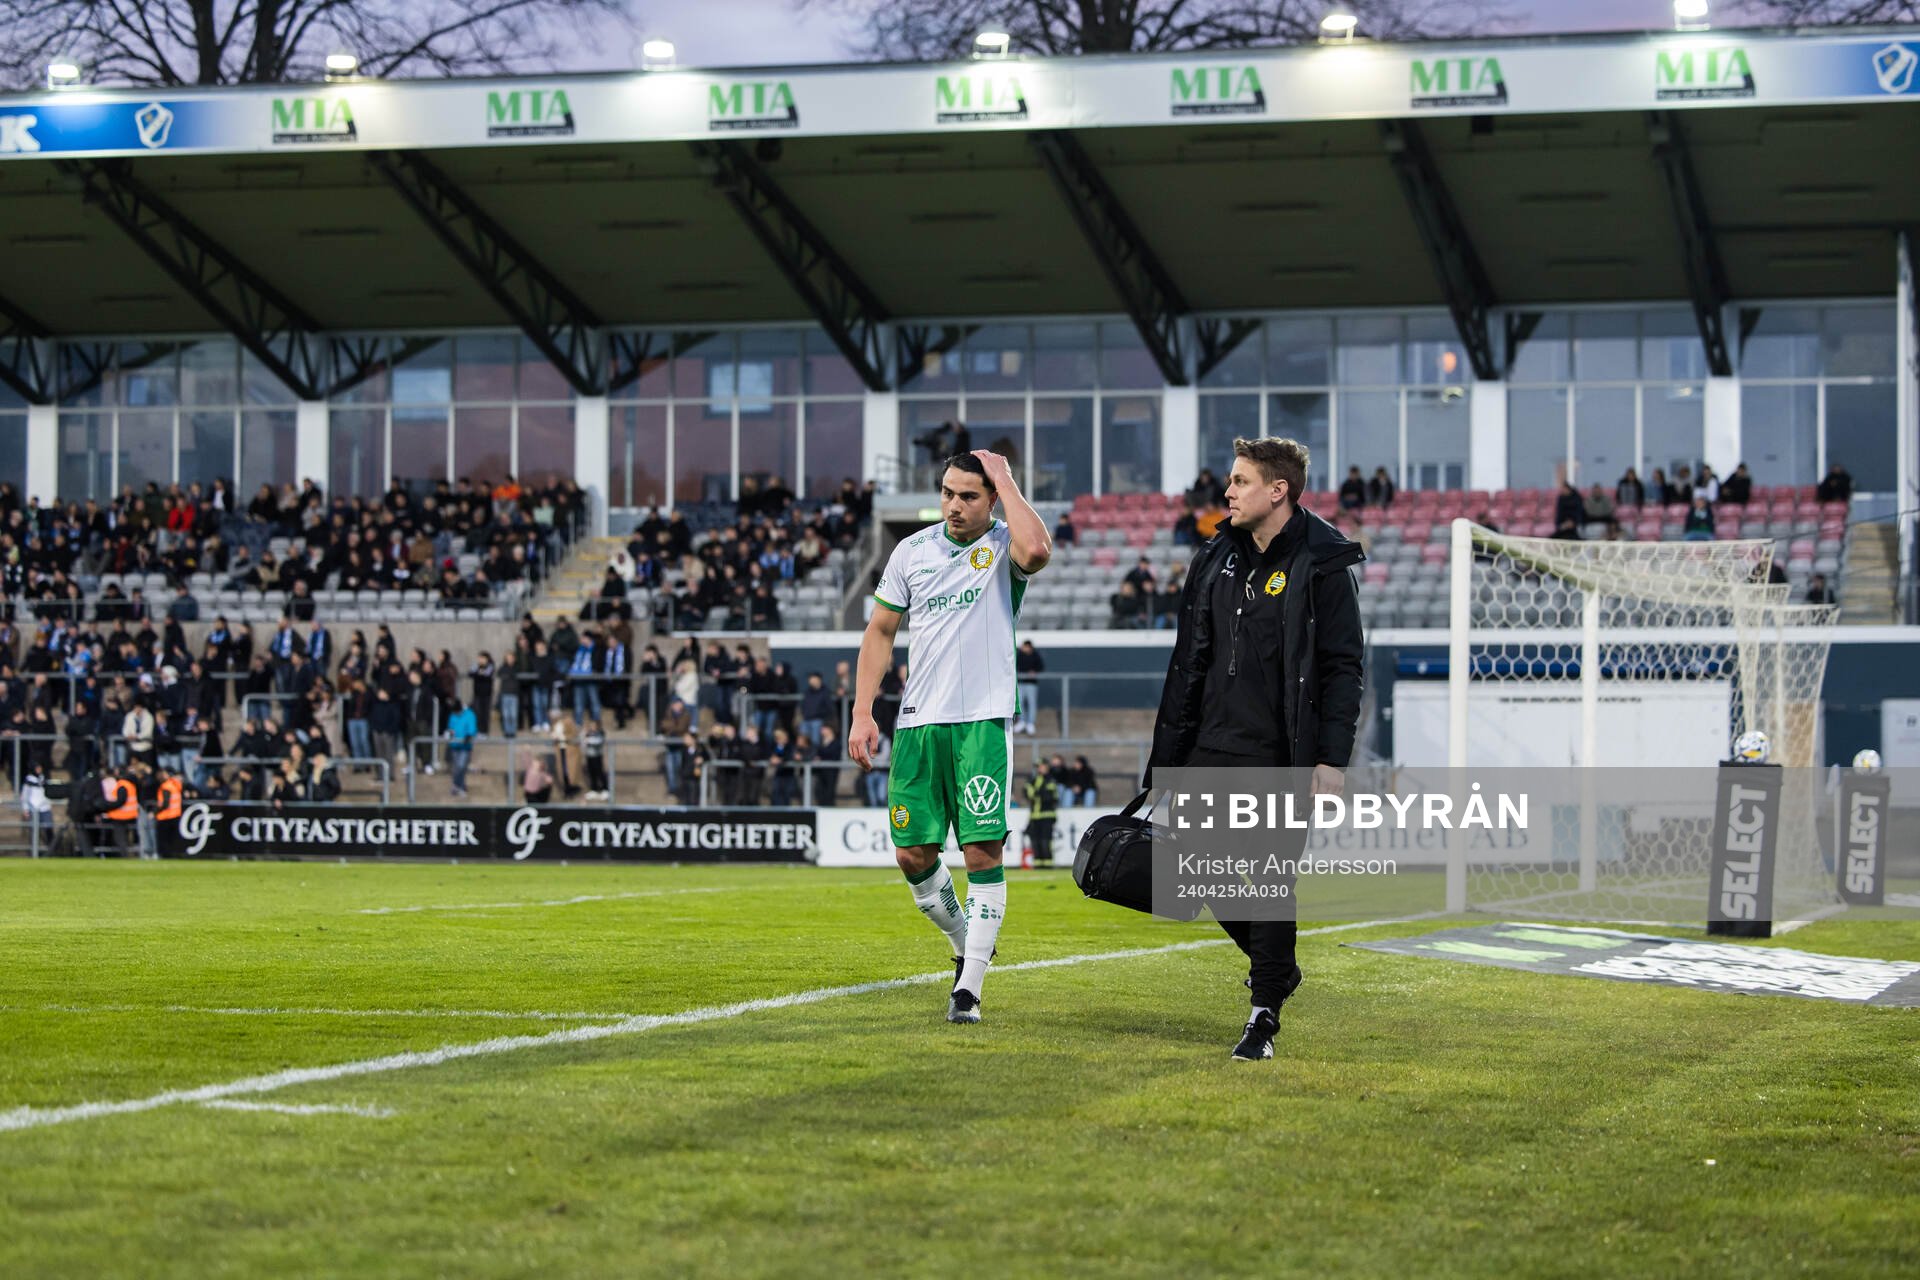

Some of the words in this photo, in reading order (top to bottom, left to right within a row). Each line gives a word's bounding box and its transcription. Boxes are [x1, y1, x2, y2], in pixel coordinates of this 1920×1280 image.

[1170, 67, 1265, 102] MTA
[1410, 58, 1507, 93] MTA
[487, 90, 574, 124] MTA
[708, 83, 798, 117] MTA
[231, 817, 479, 845] CITYFASTIGHETER
[560, 821, 816, 849] CITYFASTIGHETER
[842, 818, 889, 853] Ca
[1845, 792, 1880, 894] SELECT
[1720, 784, 1767, 920] SELECT
